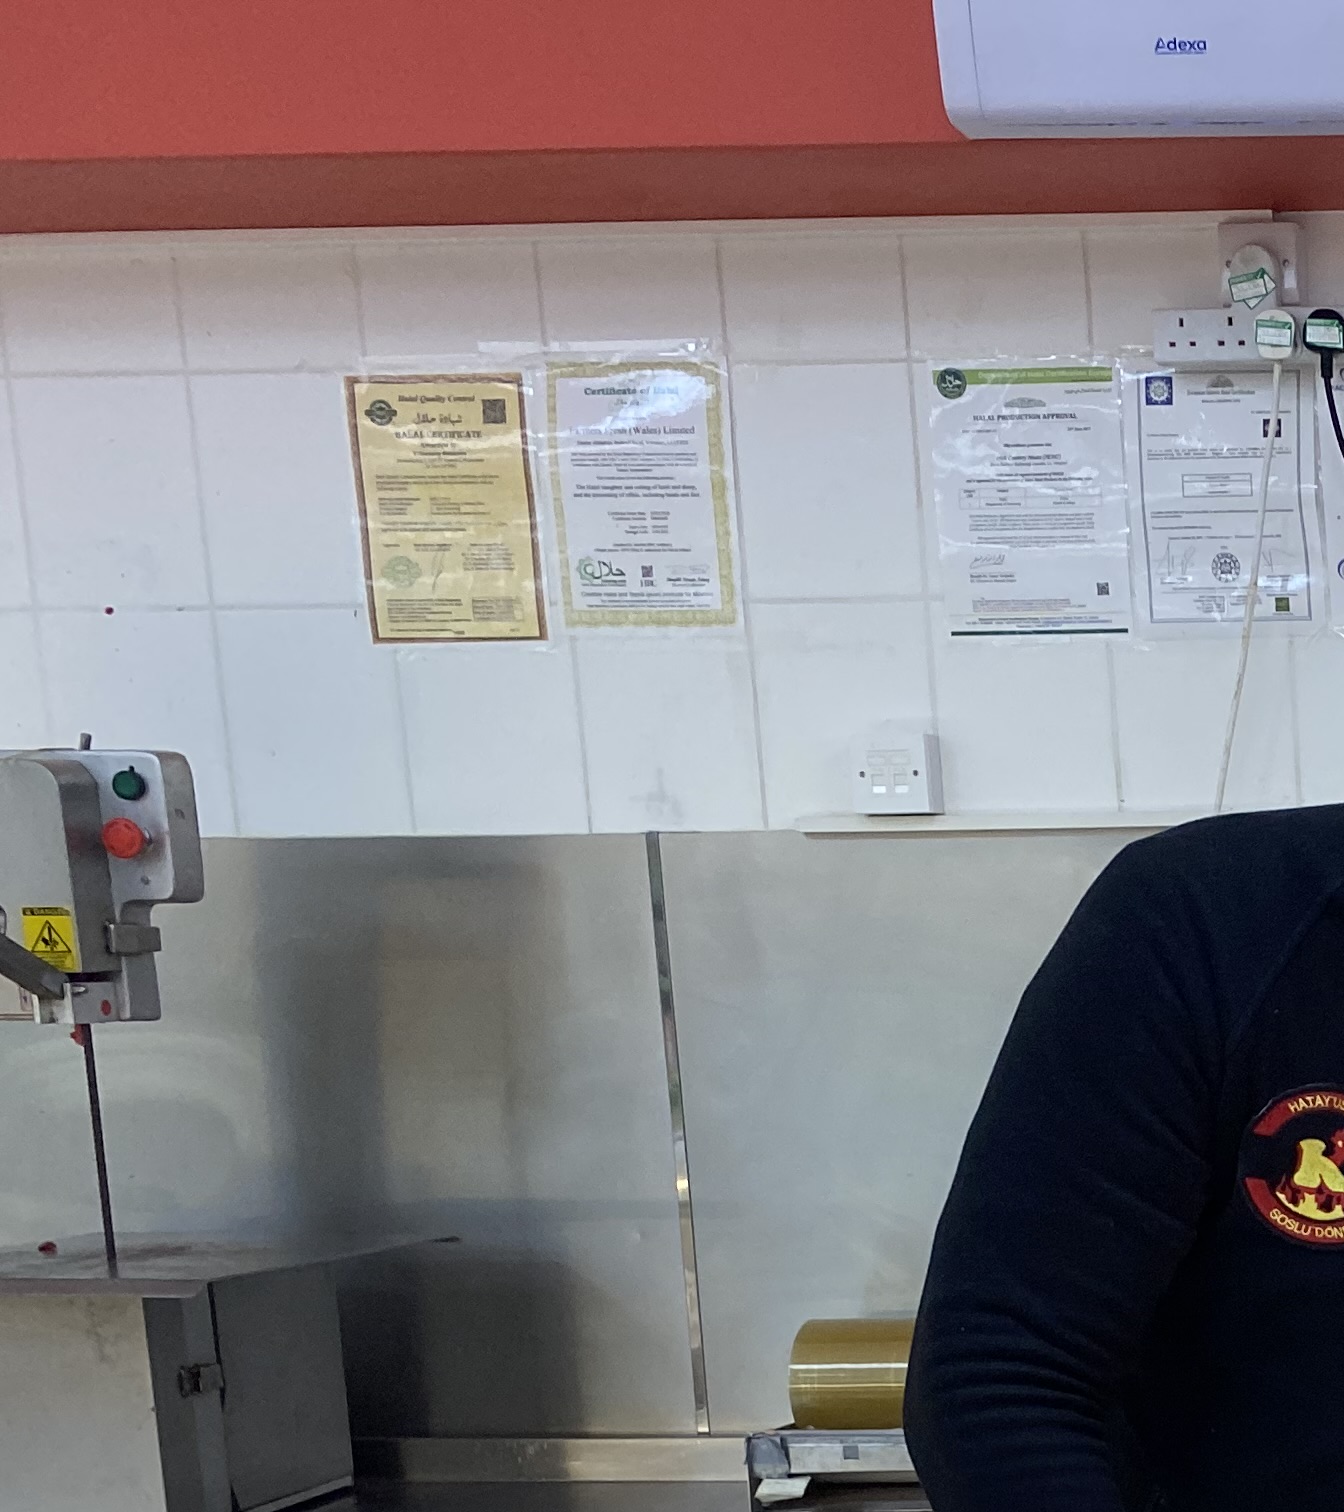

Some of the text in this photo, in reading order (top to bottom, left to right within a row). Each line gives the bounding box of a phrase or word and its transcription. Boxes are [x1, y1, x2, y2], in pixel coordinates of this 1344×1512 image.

[1154, 37, 1207, 52] Adexa
[1288, 1095, 1330, 1114] HATAY
[1269, 1208, 1311, 1237] SOSLU
